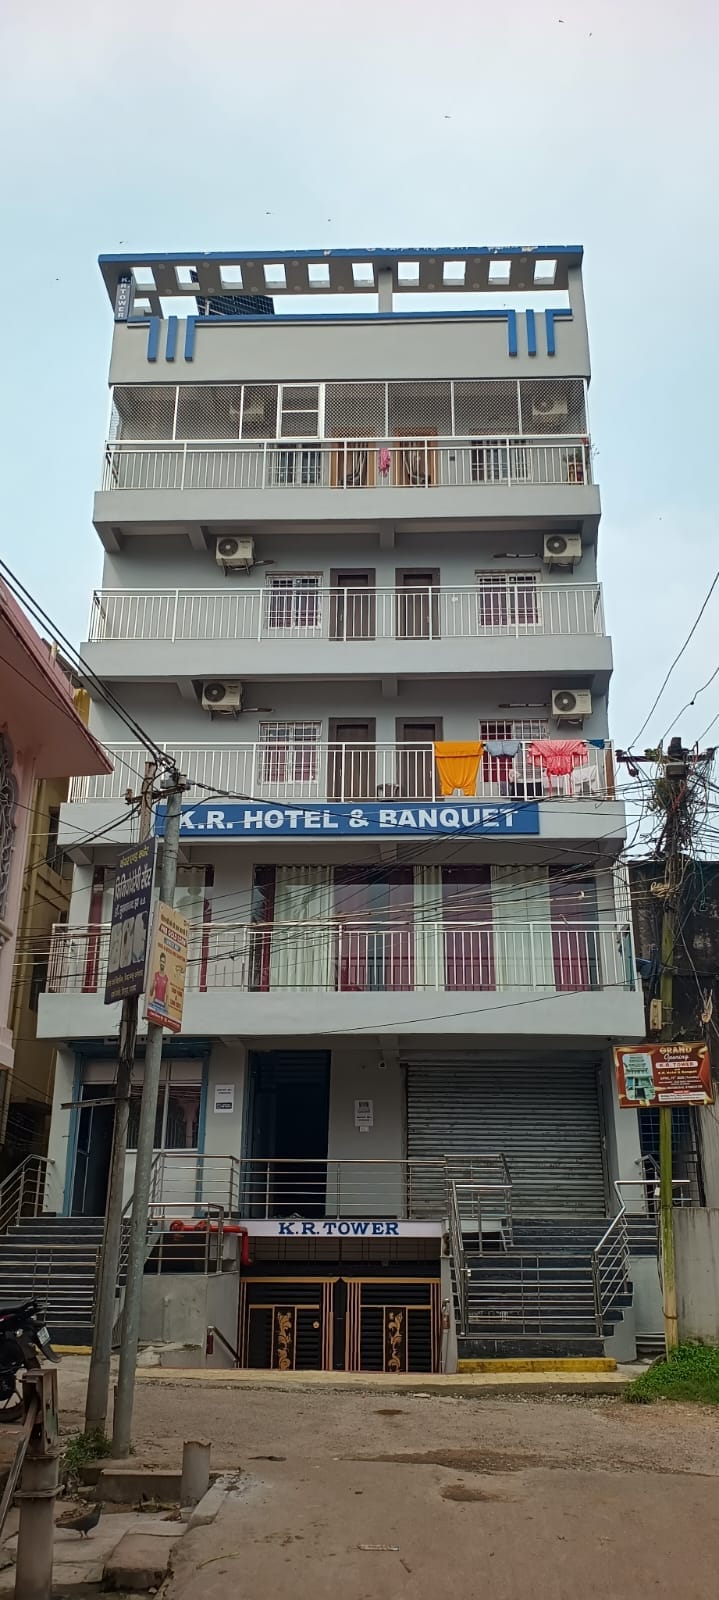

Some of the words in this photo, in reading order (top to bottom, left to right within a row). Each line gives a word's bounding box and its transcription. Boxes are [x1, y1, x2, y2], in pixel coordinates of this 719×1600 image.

[179, 810, 233, 829] K.R.
[244, 809, 339, 829] HOTEL
[349, 808, 370, 827] &
[379, 807, 519, 828] BANQUET
[664, 1053, 689, 1061] Opening
